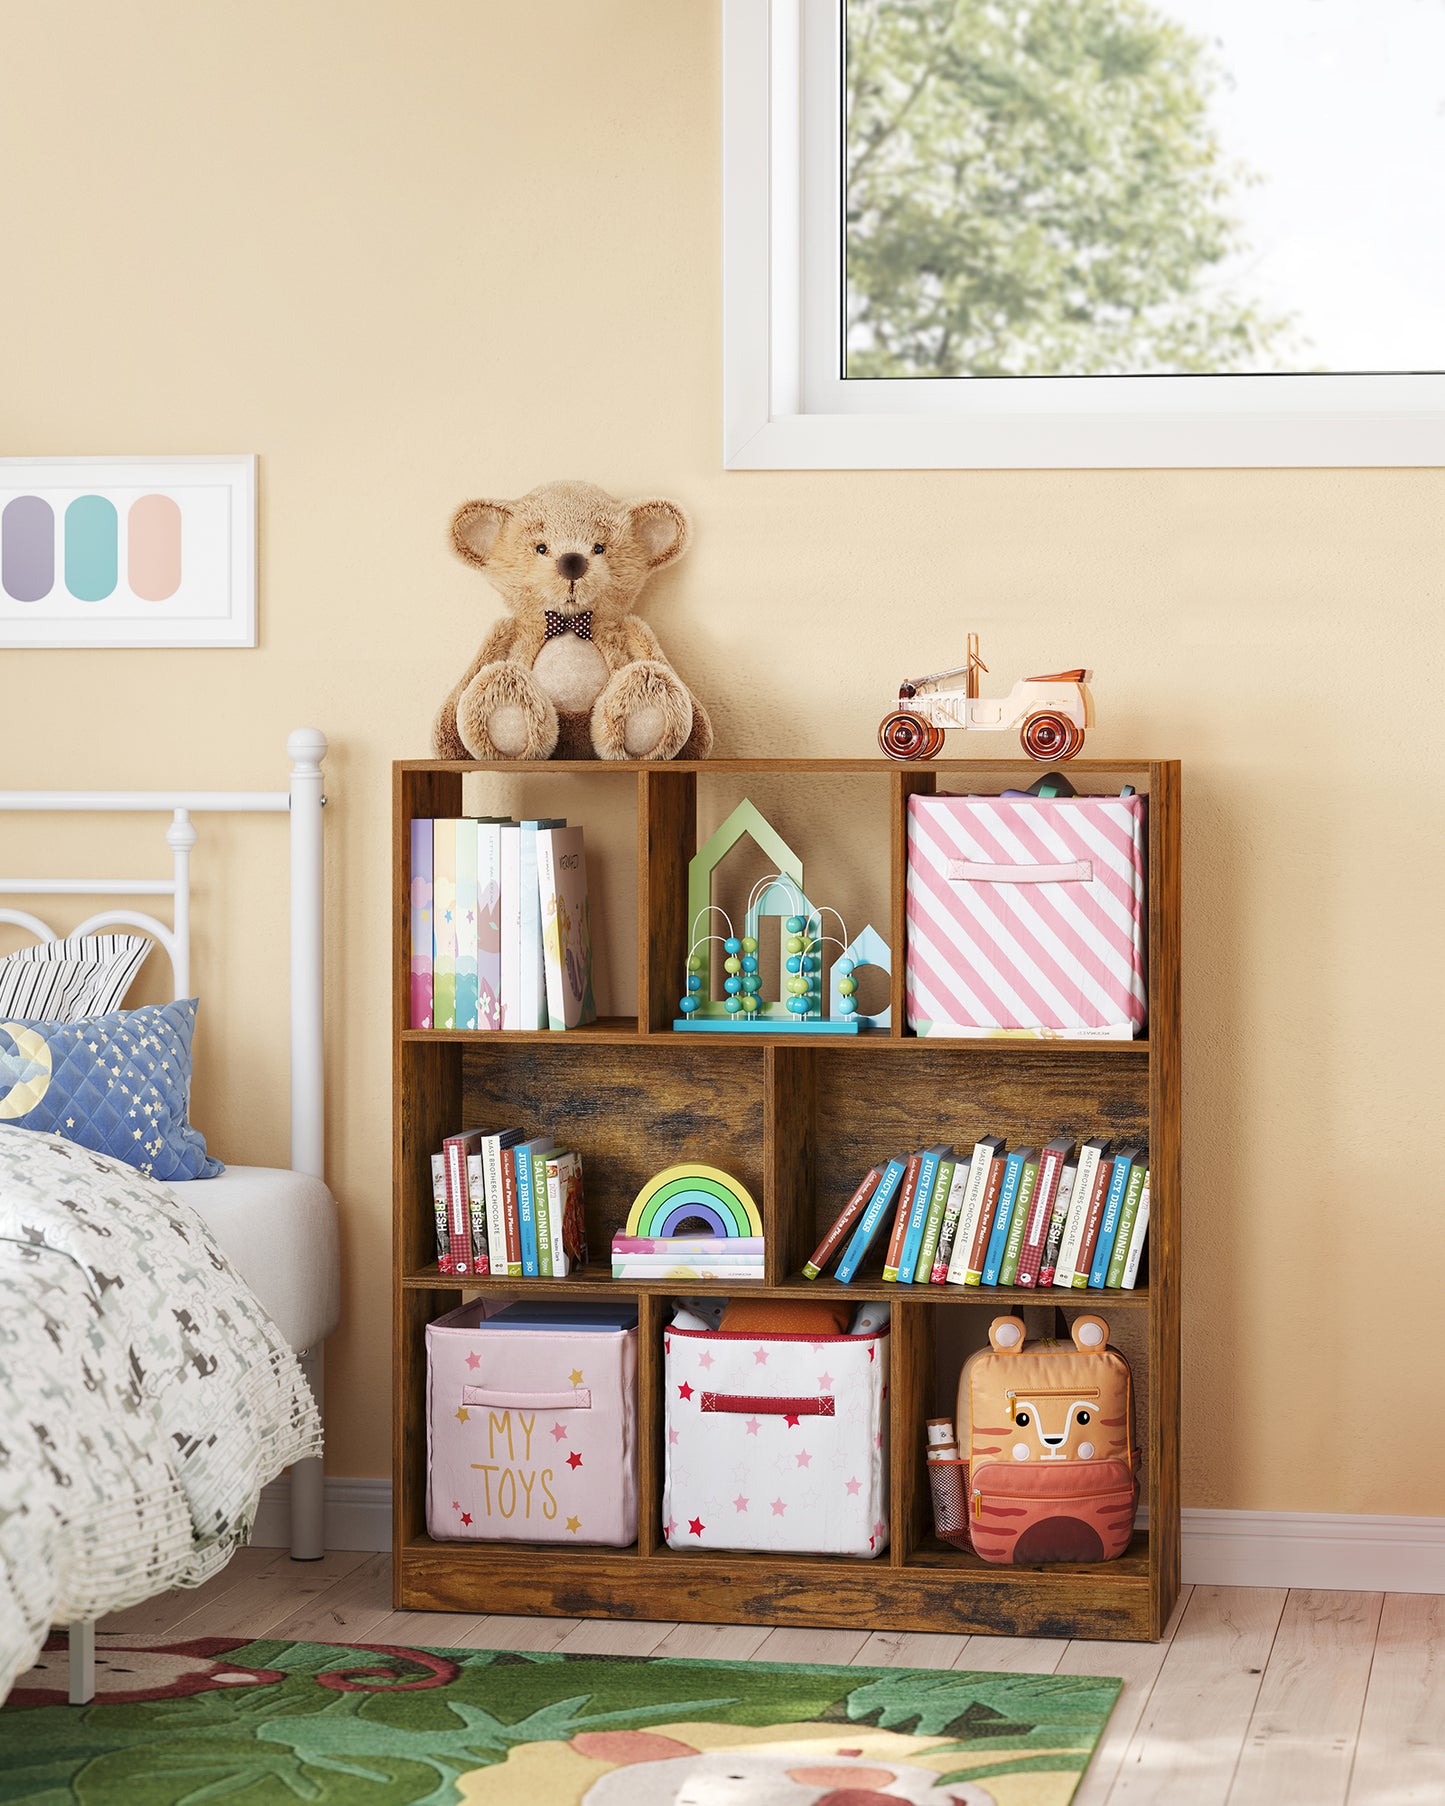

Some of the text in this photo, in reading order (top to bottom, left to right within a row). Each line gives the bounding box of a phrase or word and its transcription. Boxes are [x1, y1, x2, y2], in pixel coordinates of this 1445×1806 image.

[519, 1153, 527, 1181] JUICY
[978, 1148, 987, 1165] MAST
[1085, 1150, 1094, 1168] MAST
[489, 1158, 497, 1193] BROTHERS
[534, 1161, 544, 1194] SALAD
[935, 1168, 949, 1201] SALAD
[970, 1167, 983, 1201] BROTHERS
[1020, 1169, 1034, 1203] SALAD
[1077, 1169, 1090, 1204] BROTHERS
[521, 1183, 530, 1221] DRINKS
[537, 1197, 545, 1207] for
[854, 1195, 864, 1205] One
[863, 1168, 898, 1232] JUICY DRINKS
[912, 1160, 934, 1228] JUICY DRINKS
[933, 1203, 941, 1214] for
[997, 1161, 1018, 1230] JUICY DRINKS
[1017, 1204, 1025, 1216] for
[1104, 1163, 1126, 1232] JUICY DRINKS
[435, 1198, 447, 1231] FRESH
[472, 1199, 482, 1232] FRESH
[491, 1194, 500, 1234] CHOCOLATE
[538, 1210, 548, 1249] DINNER
[839, 1217, 848, 1227] Two
[941, 1207, 958, 1242] FRESH
[961, 1203, 975, 1243] CHOCOLATE
[982, 1214, 990, 1225] Two
[1048, 1209, 1065, 1244] FRESH
[1068, 1205, 1082, 1245] CHOCOLATE
[1115, 1171, 1141, 1261] SALAD for DINNER
[828, 1227, 841, 1243] Plates
[896, 1223, 904, 1240] Plates
[923, 1217, 938, 1256] DINNER
[978, 1226, 987, 1244] Plates
[1007, 1219, 1023, 1258] DINNER
[1086, 1228, 1094, 1246] Plates
[489, 1411, 535, 1461] MY
[471, 1464, 558, 1520] TOYS
